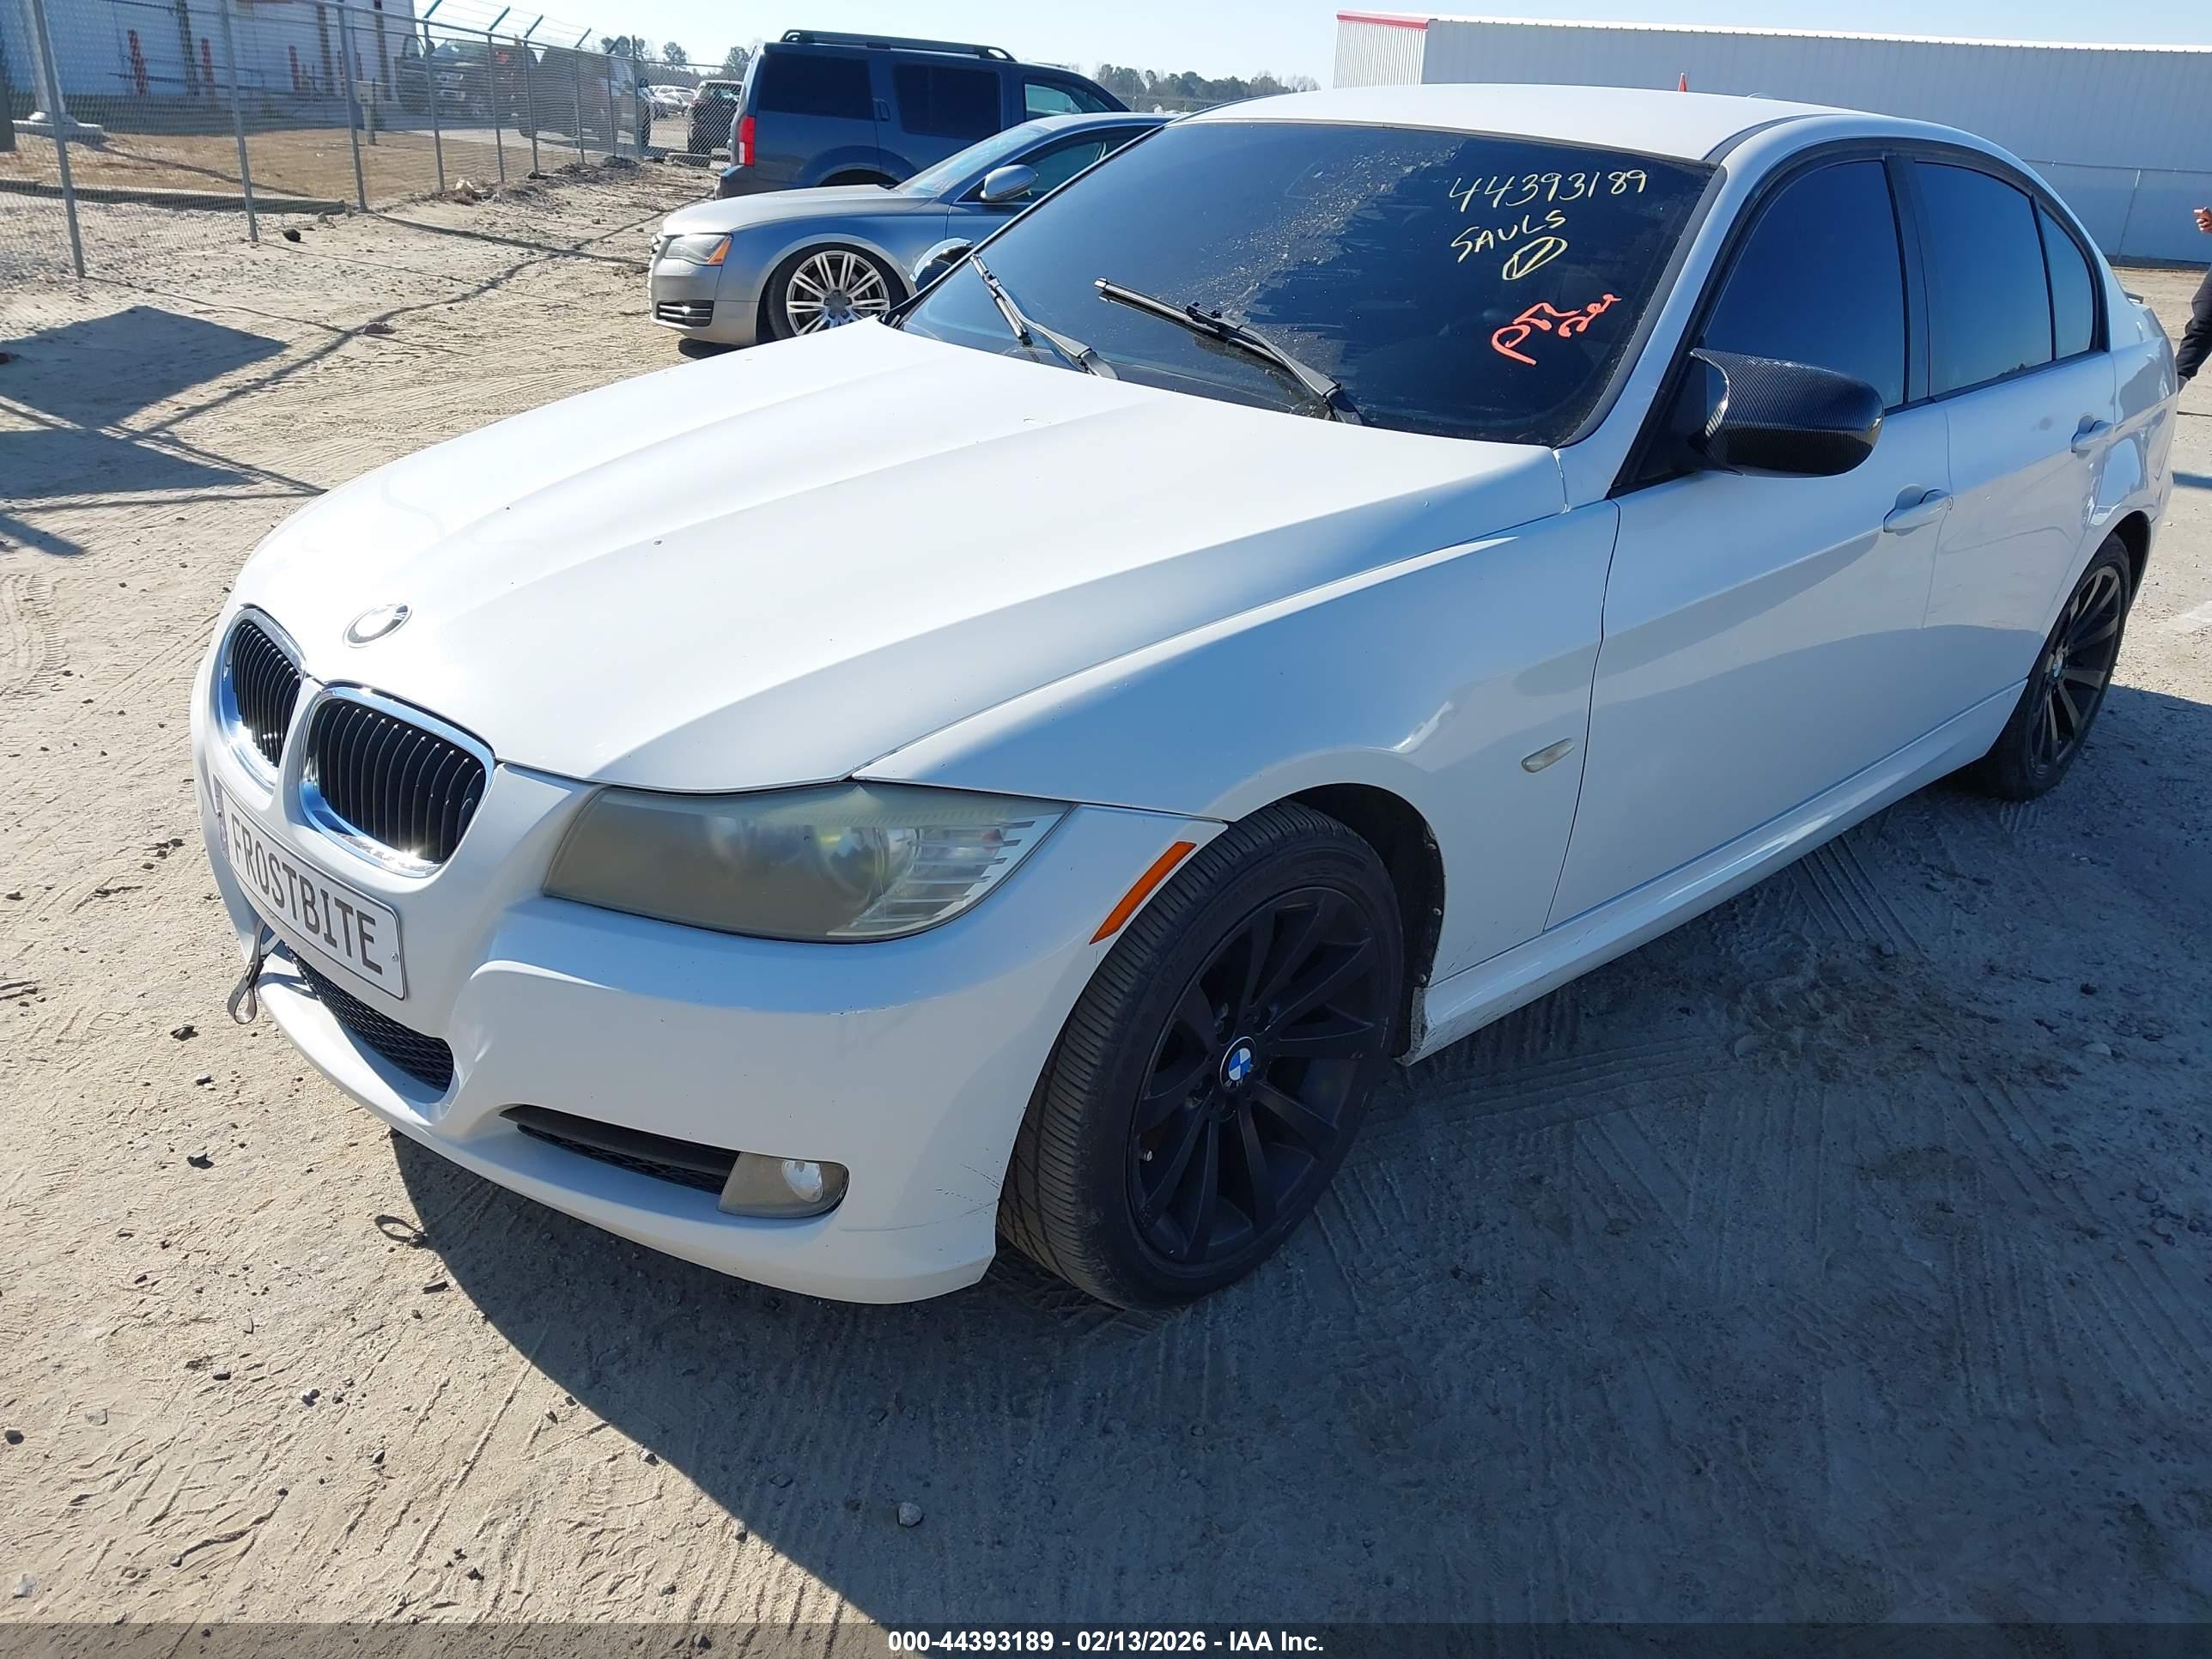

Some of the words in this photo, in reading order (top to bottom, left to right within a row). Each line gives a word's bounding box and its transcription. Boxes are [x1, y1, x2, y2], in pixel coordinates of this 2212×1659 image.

[1449, 169, 1648, 213] 44393189
[1450, 210, 1567, 263] SAULS
[231, 812, 383, 975] FROSTBITE
